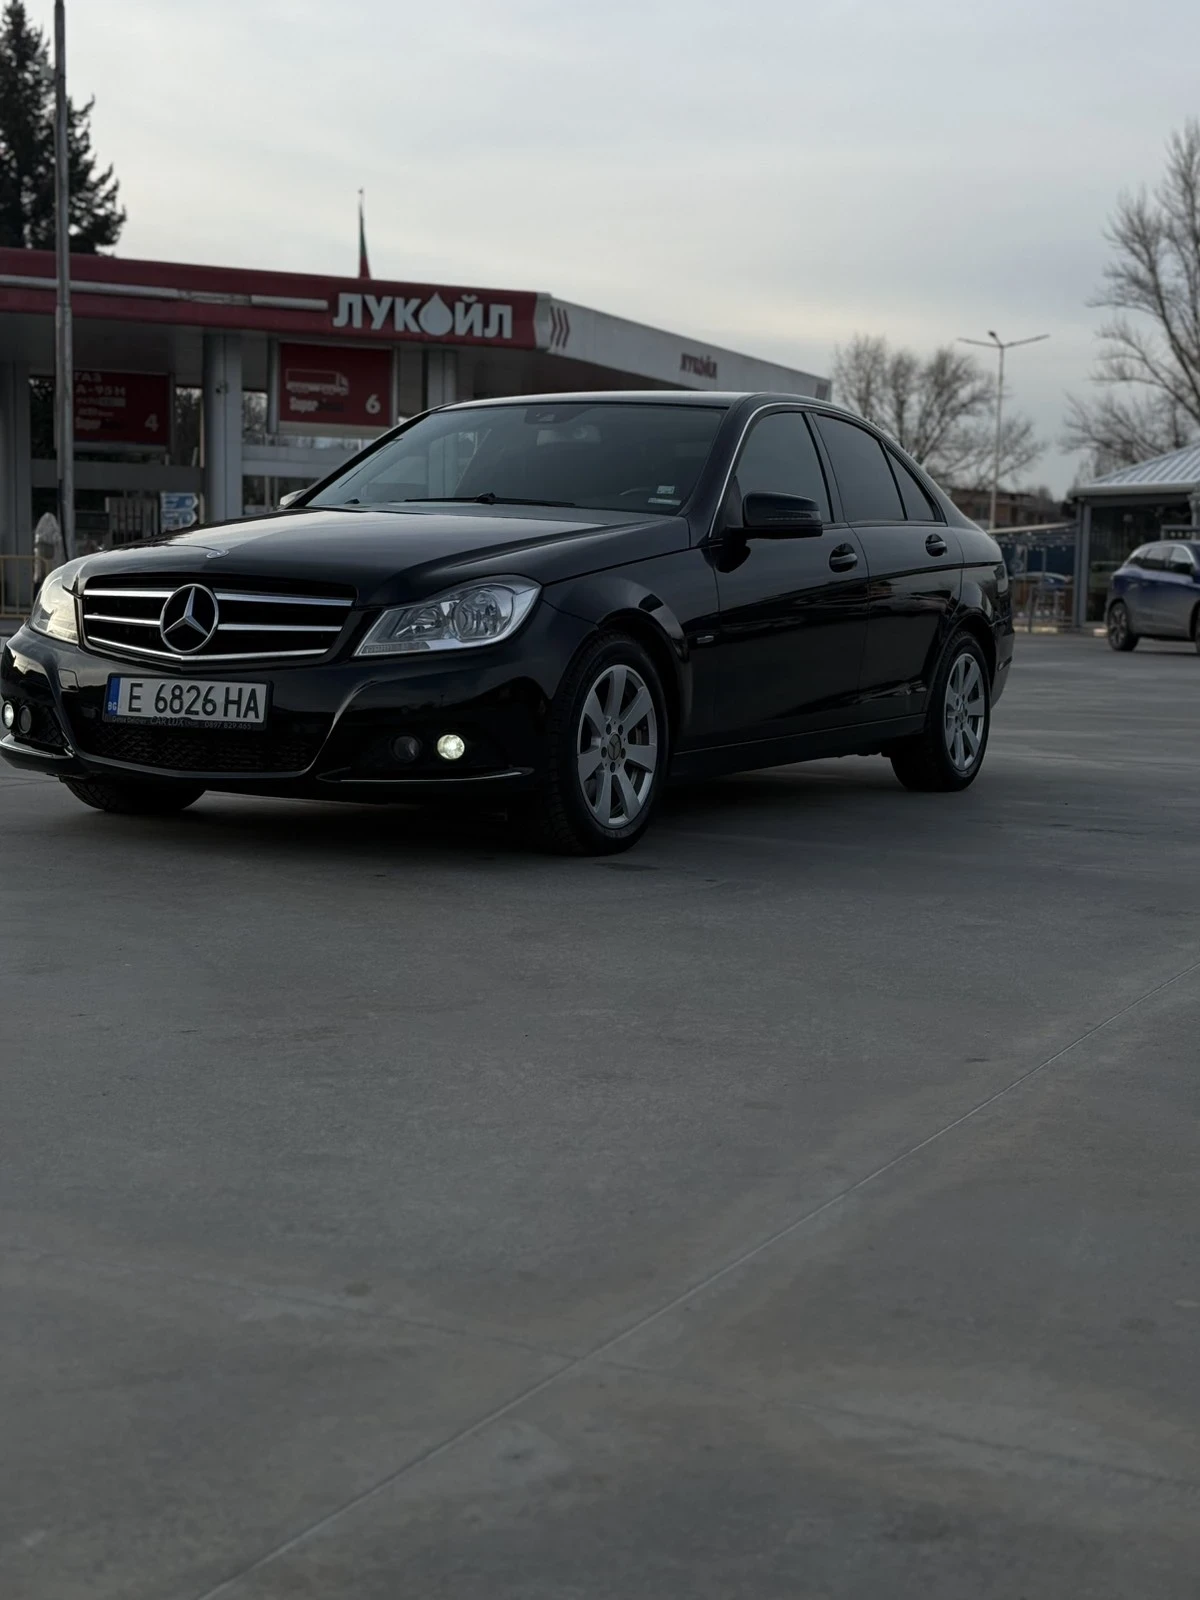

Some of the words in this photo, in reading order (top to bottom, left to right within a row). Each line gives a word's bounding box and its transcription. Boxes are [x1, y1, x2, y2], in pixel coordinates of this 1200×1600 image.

[332, 291, 513, 339] ЛУКОЙЛ
[365, 393, 381, 415] 6
[144, 412, 160, 433] 4
[107, 701, 117, 711] BG
[128, 682, 143, 713] E
[154, 684, 217, 716] 6826
[223, 686, 260, 719] HA
